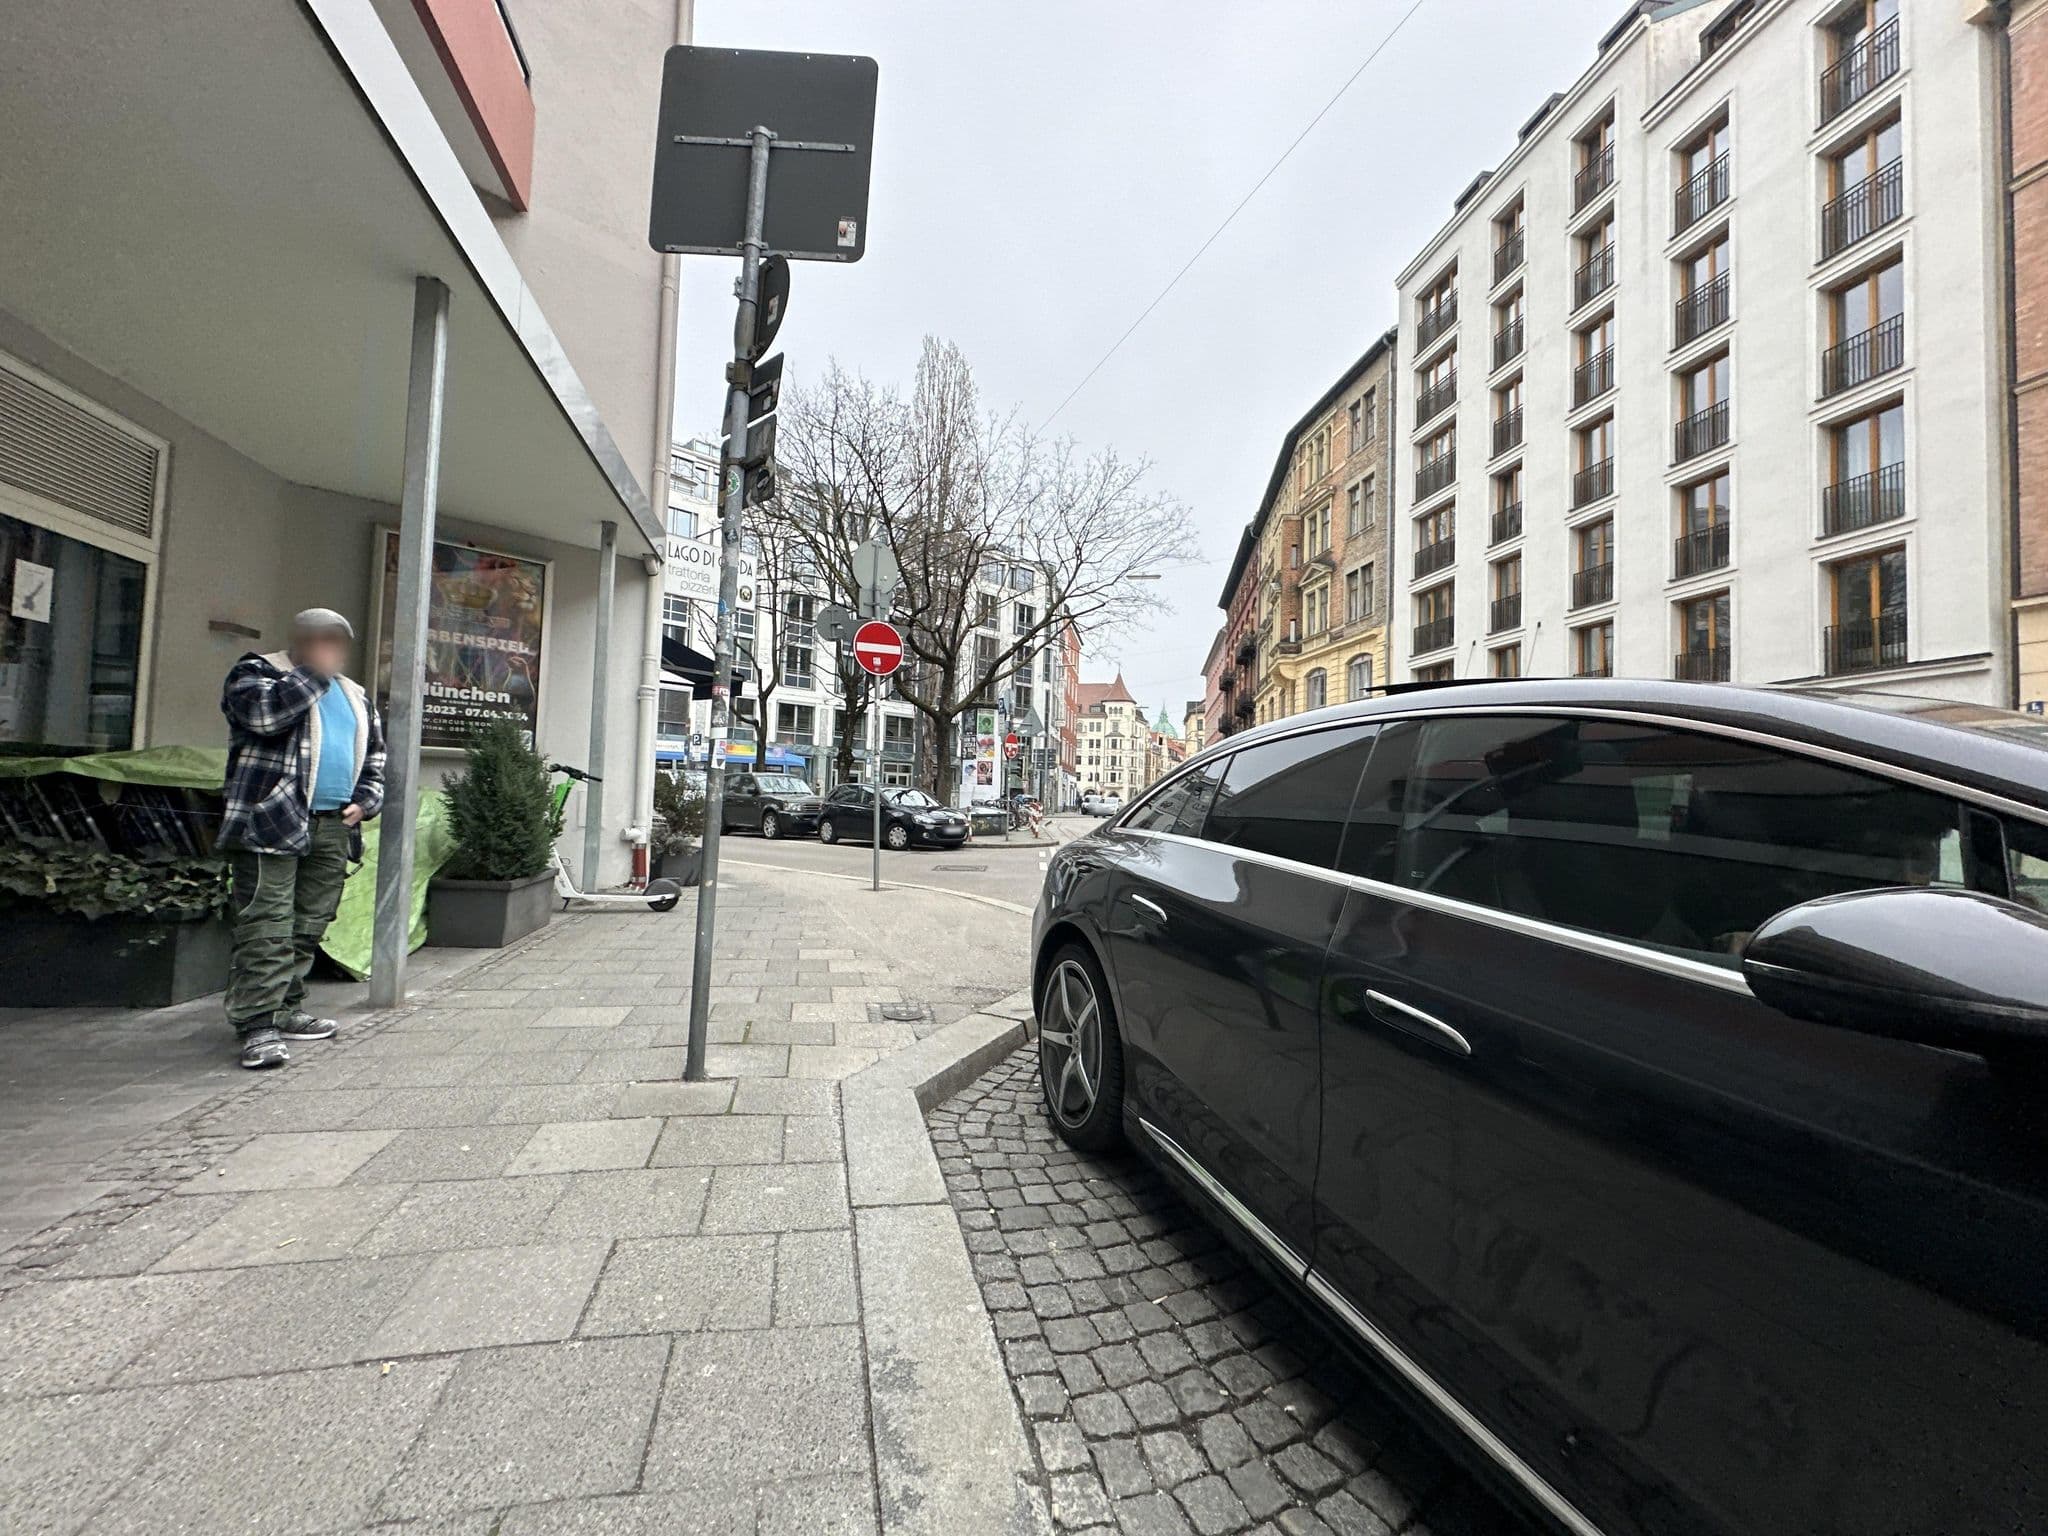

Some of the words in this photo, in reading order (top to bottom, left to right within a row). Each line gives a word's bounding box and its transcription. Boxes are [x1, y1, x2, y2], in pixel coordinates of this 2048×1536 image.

[668, 541, 700, 563] LAGO
[703, 550, 715, 567] DI
[668, 563, 710, 583] trattoria
